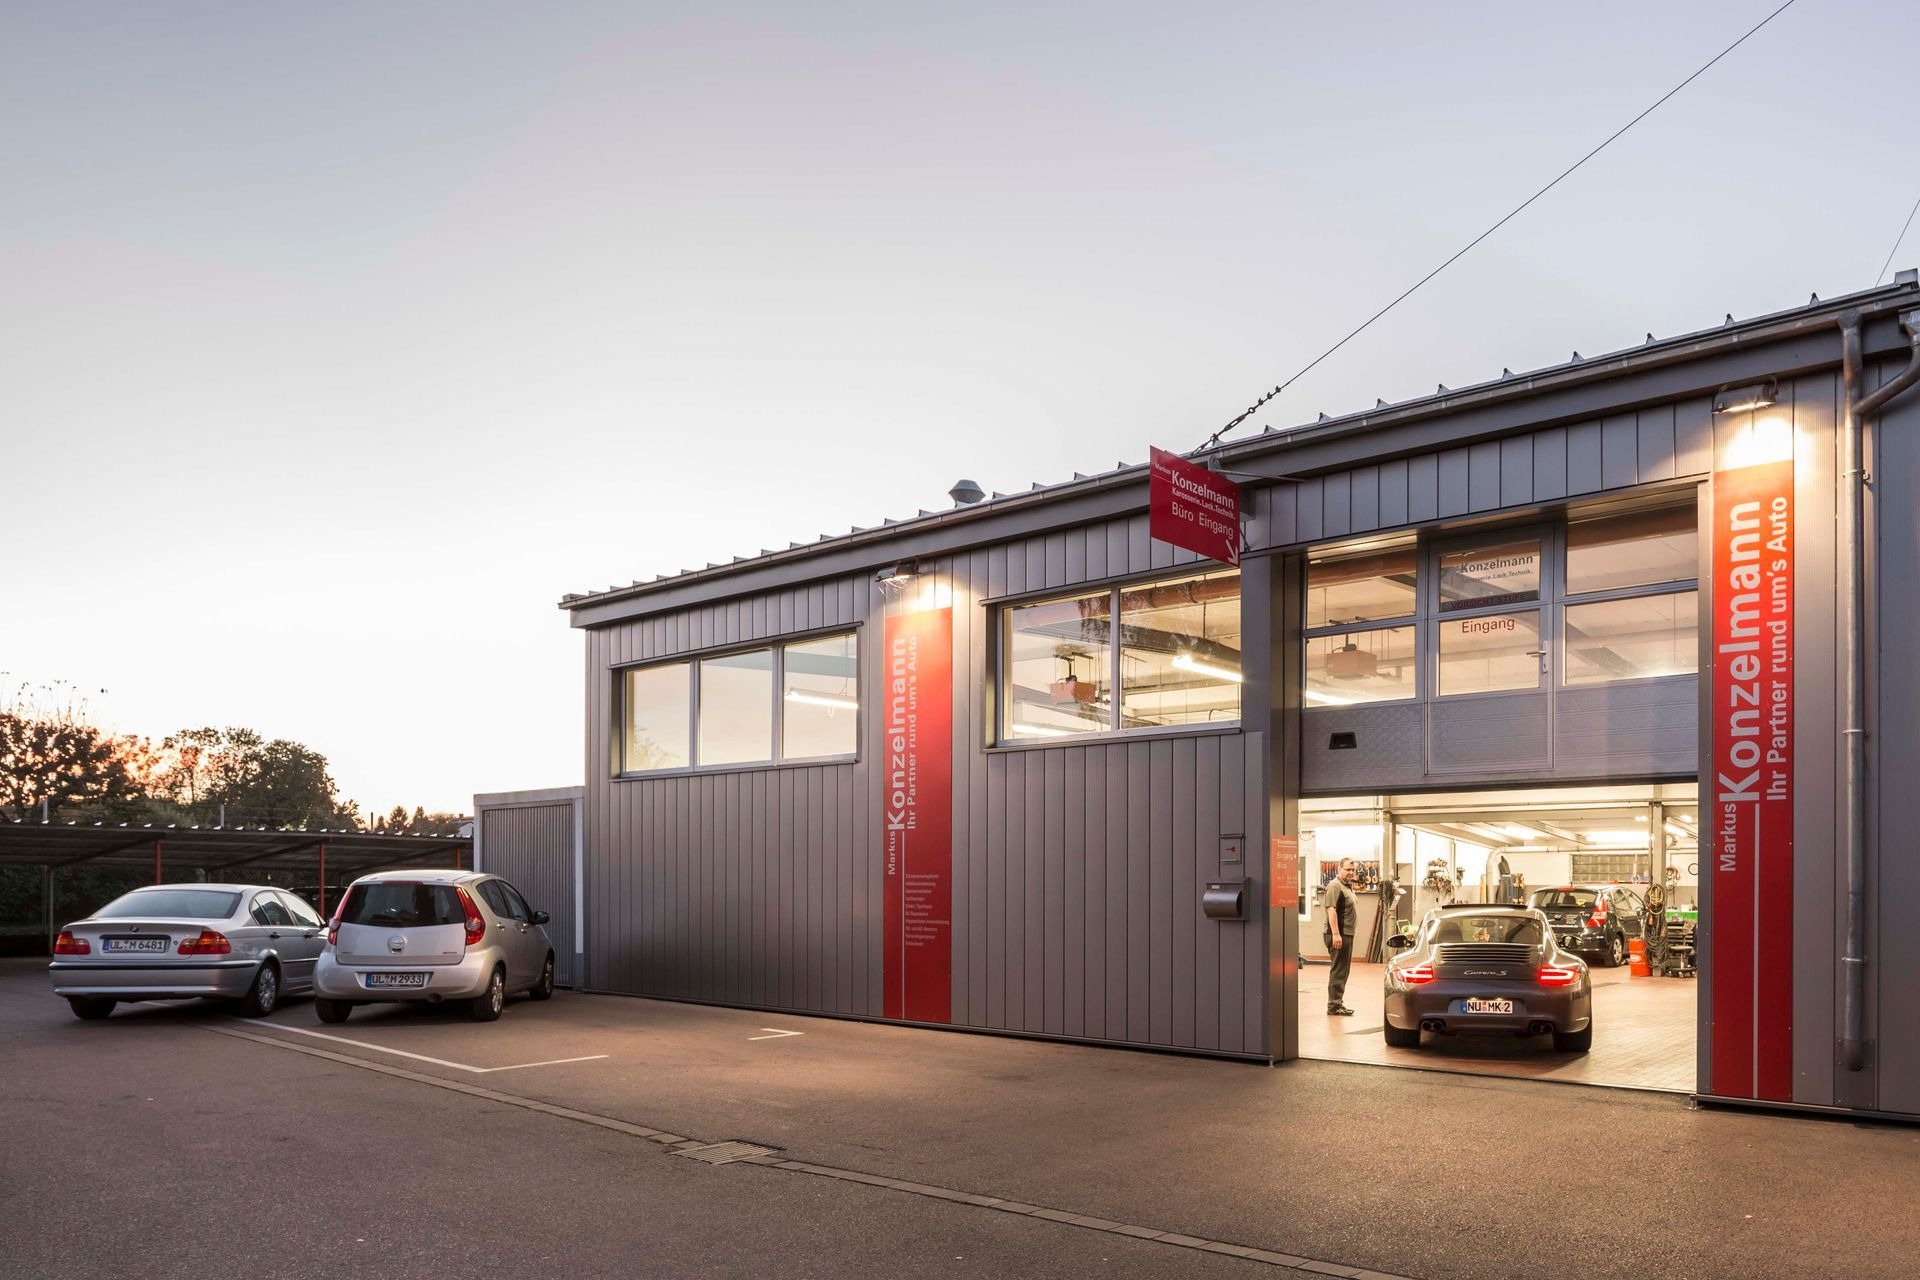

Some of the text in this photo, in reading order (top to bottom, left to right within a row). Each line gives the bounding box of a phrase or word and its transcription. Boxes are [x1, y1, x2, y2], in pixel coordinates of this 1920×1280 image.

[1172, 470, 1234, 509] Konzelmann
[1172, 502, 1234, 540] Büro Eingang
[1766, 496, 1788, 552] Auto
[1461, 556, 1533, 573] Konzelmann
[1462, 619, 1514, 634] Eingang
[908, 636, 918, 672] Auto
[1767, 620, 1786, 672] rund
[1718, 501, 1760, 871] Markus Konzelmann
[908, 714, 916, 748] rund
[1767, 680, 1786, 763] Partner
[888, 638, 906, 874] Markus Konzelmann
[907, 752, 916, 805] Partner
[1767, 771, 1786, 800] Ihr
[907, 810, 916, 830] Ihr
[110, 940, 122, 950] UL
[372, 974, 384, 984] UL
[1468, 1002, 1510, 1012] NU MK 2
